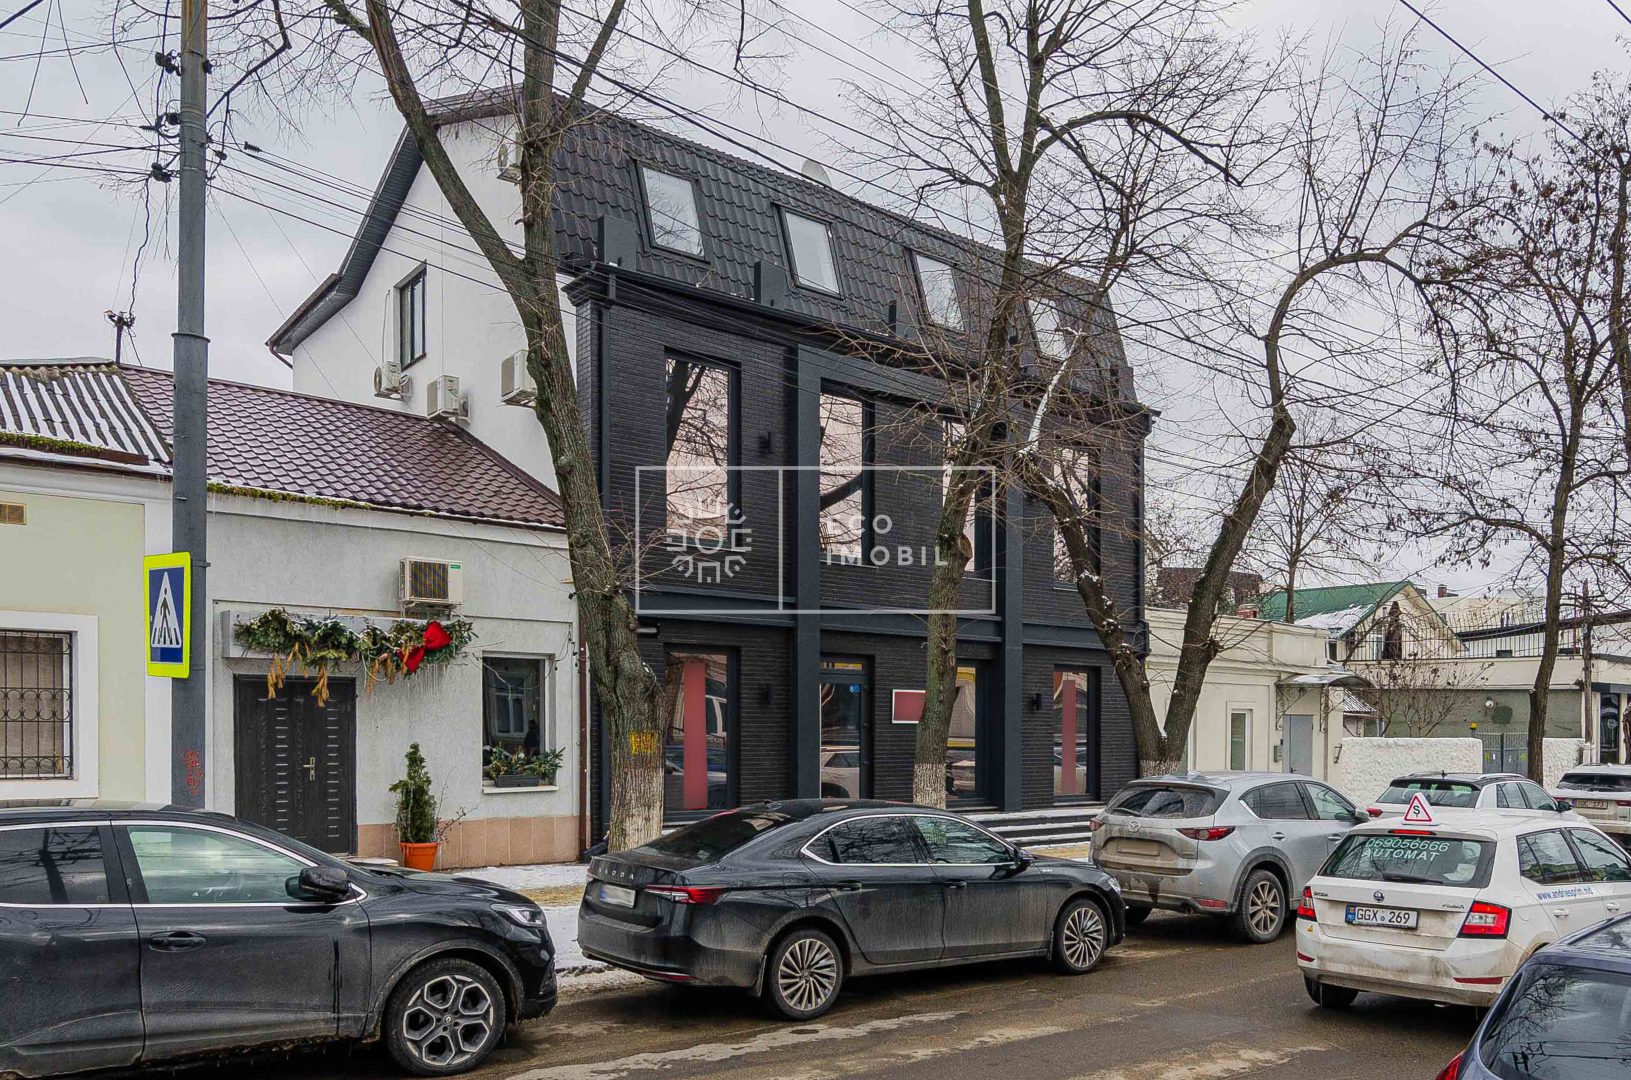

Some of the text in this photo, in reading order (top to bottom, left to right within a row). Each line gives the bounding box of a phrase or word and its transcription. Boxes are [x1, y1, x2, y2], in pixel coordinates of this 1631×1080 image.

[1365, 838, 1450, 852] 069056666
[1361, 847, 1440, 862] AUTOMAT
[1356, 908, 1378, 922] GGX
[1388, 911, 1410, 924] 269
